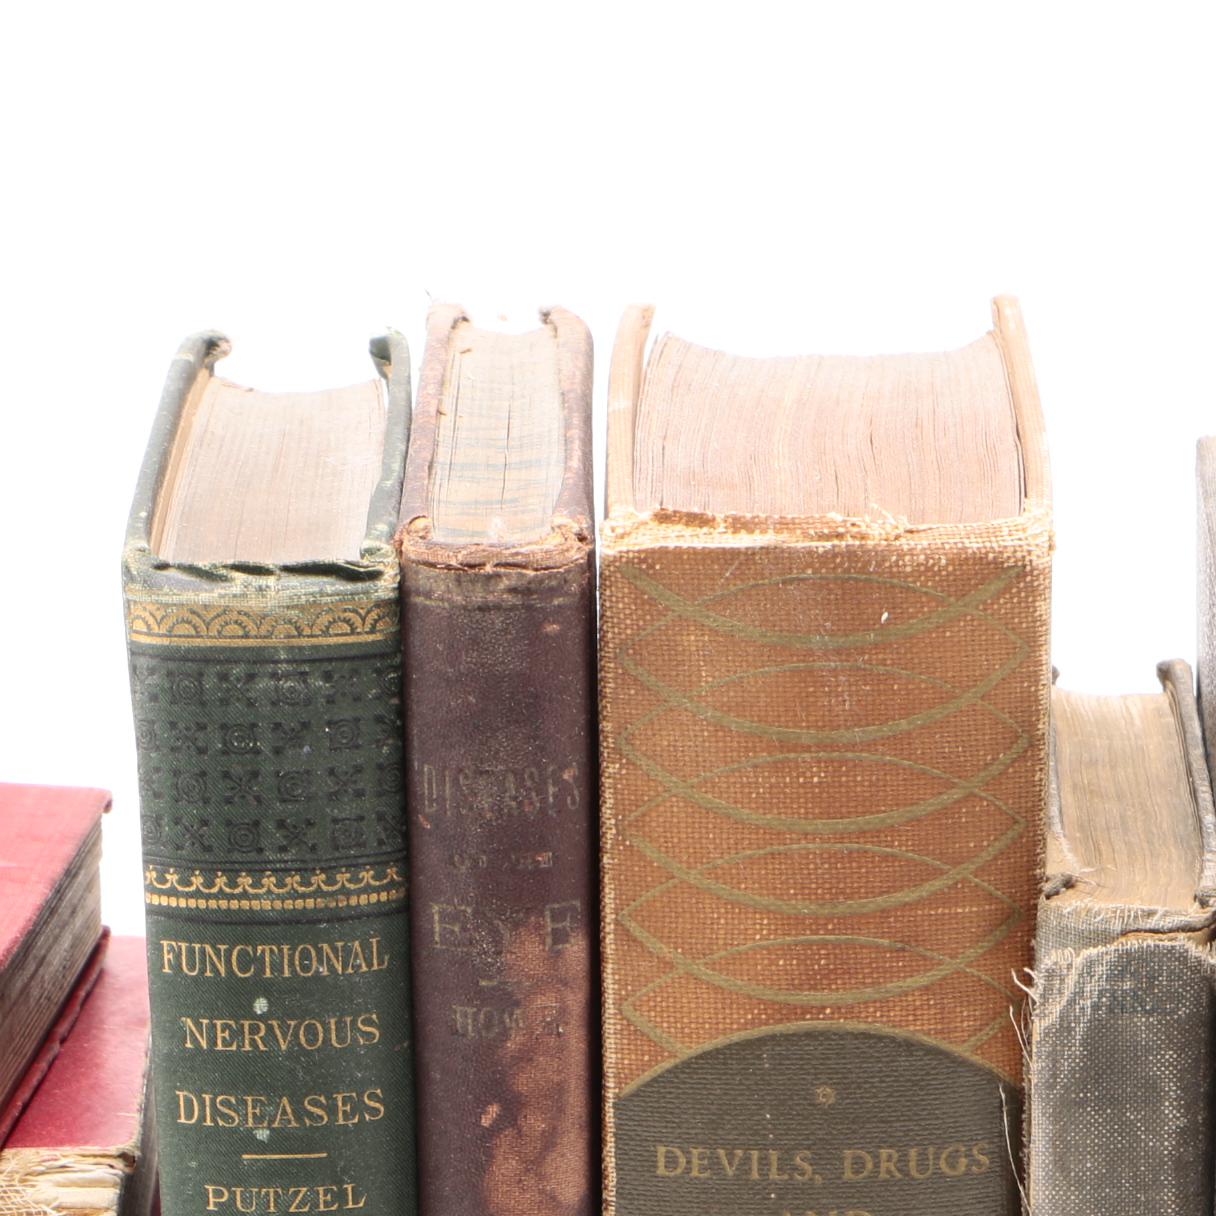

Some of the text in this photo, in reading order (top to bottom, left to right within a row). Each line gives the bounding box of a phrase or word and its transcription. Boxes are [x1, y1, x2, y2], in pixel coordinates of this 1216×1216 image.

[160, 937, 390, 979] FUNCTIONAL
[181, 1013, 381, 1052] NERVOUS
[175, 1089, 386, 1130] DISEASES
[842, 1142, 991, 1181] DRUGS
[204, 1183, 367, 1214] PUTZEL
